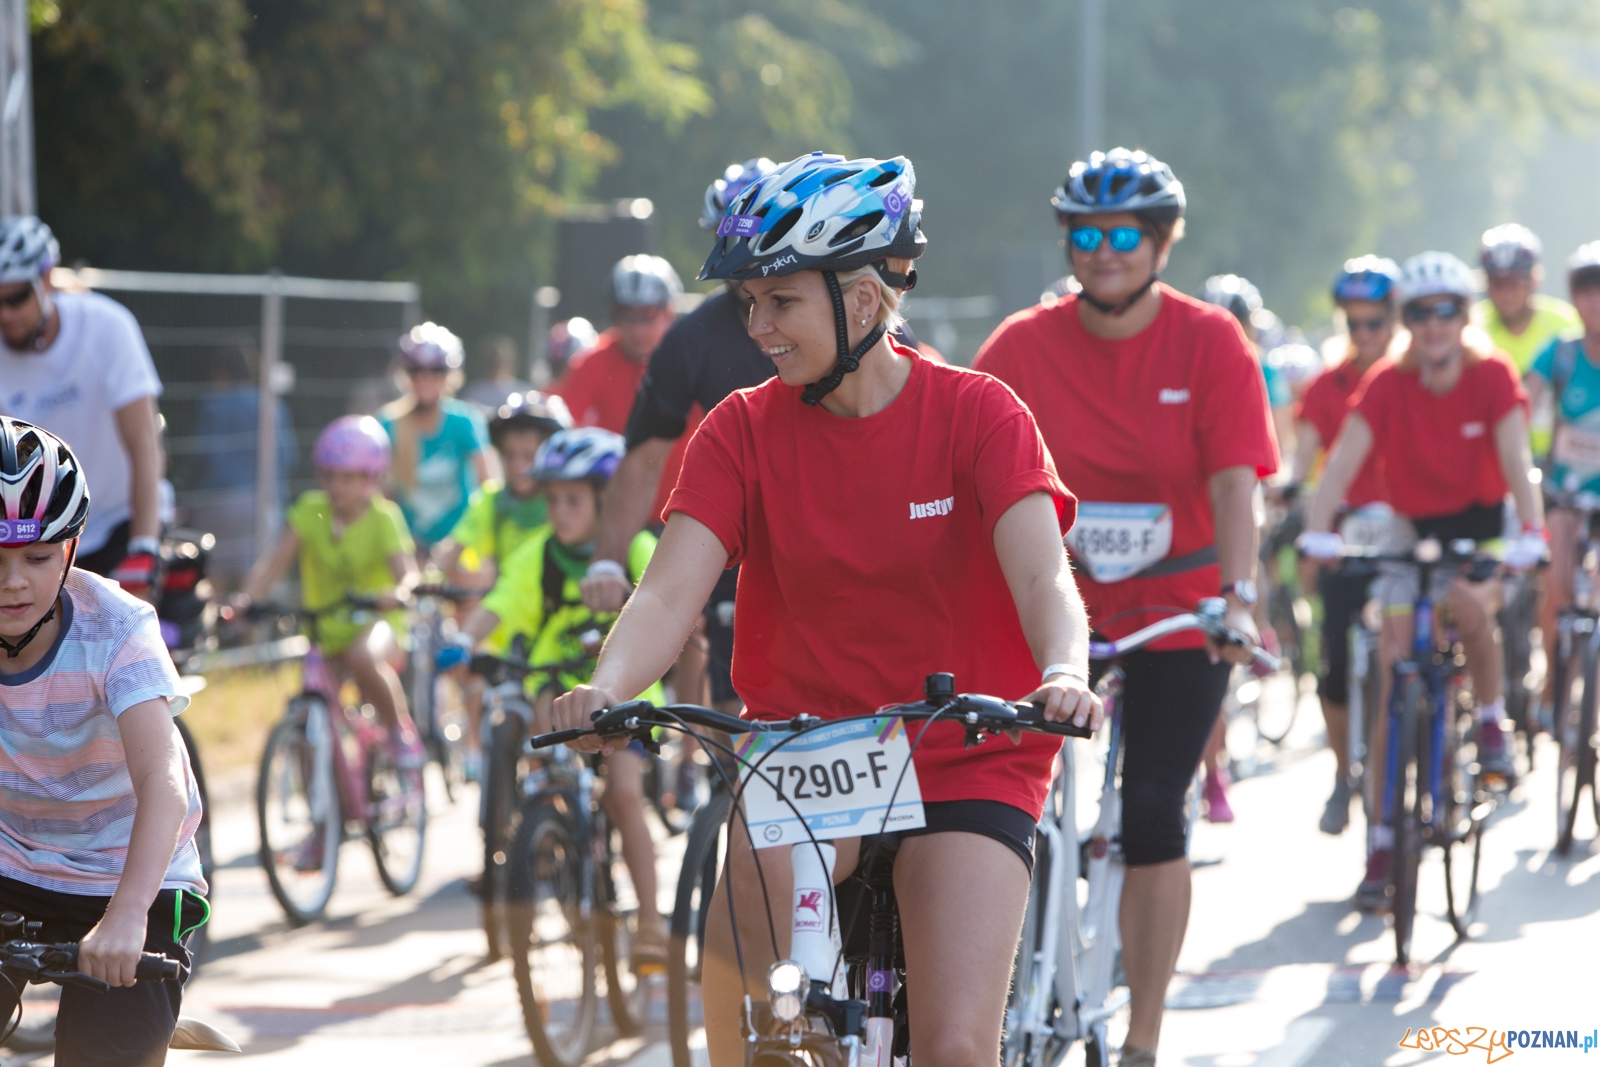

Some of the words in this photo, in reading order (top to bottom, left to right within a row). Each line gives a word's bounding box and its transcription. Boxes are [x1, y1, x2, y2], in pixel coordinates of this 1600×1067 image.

[737, 218, 754, 229] 7290
[17, 523, 36, 533] 6412
[766, 751, 888, 801] 7290-F
